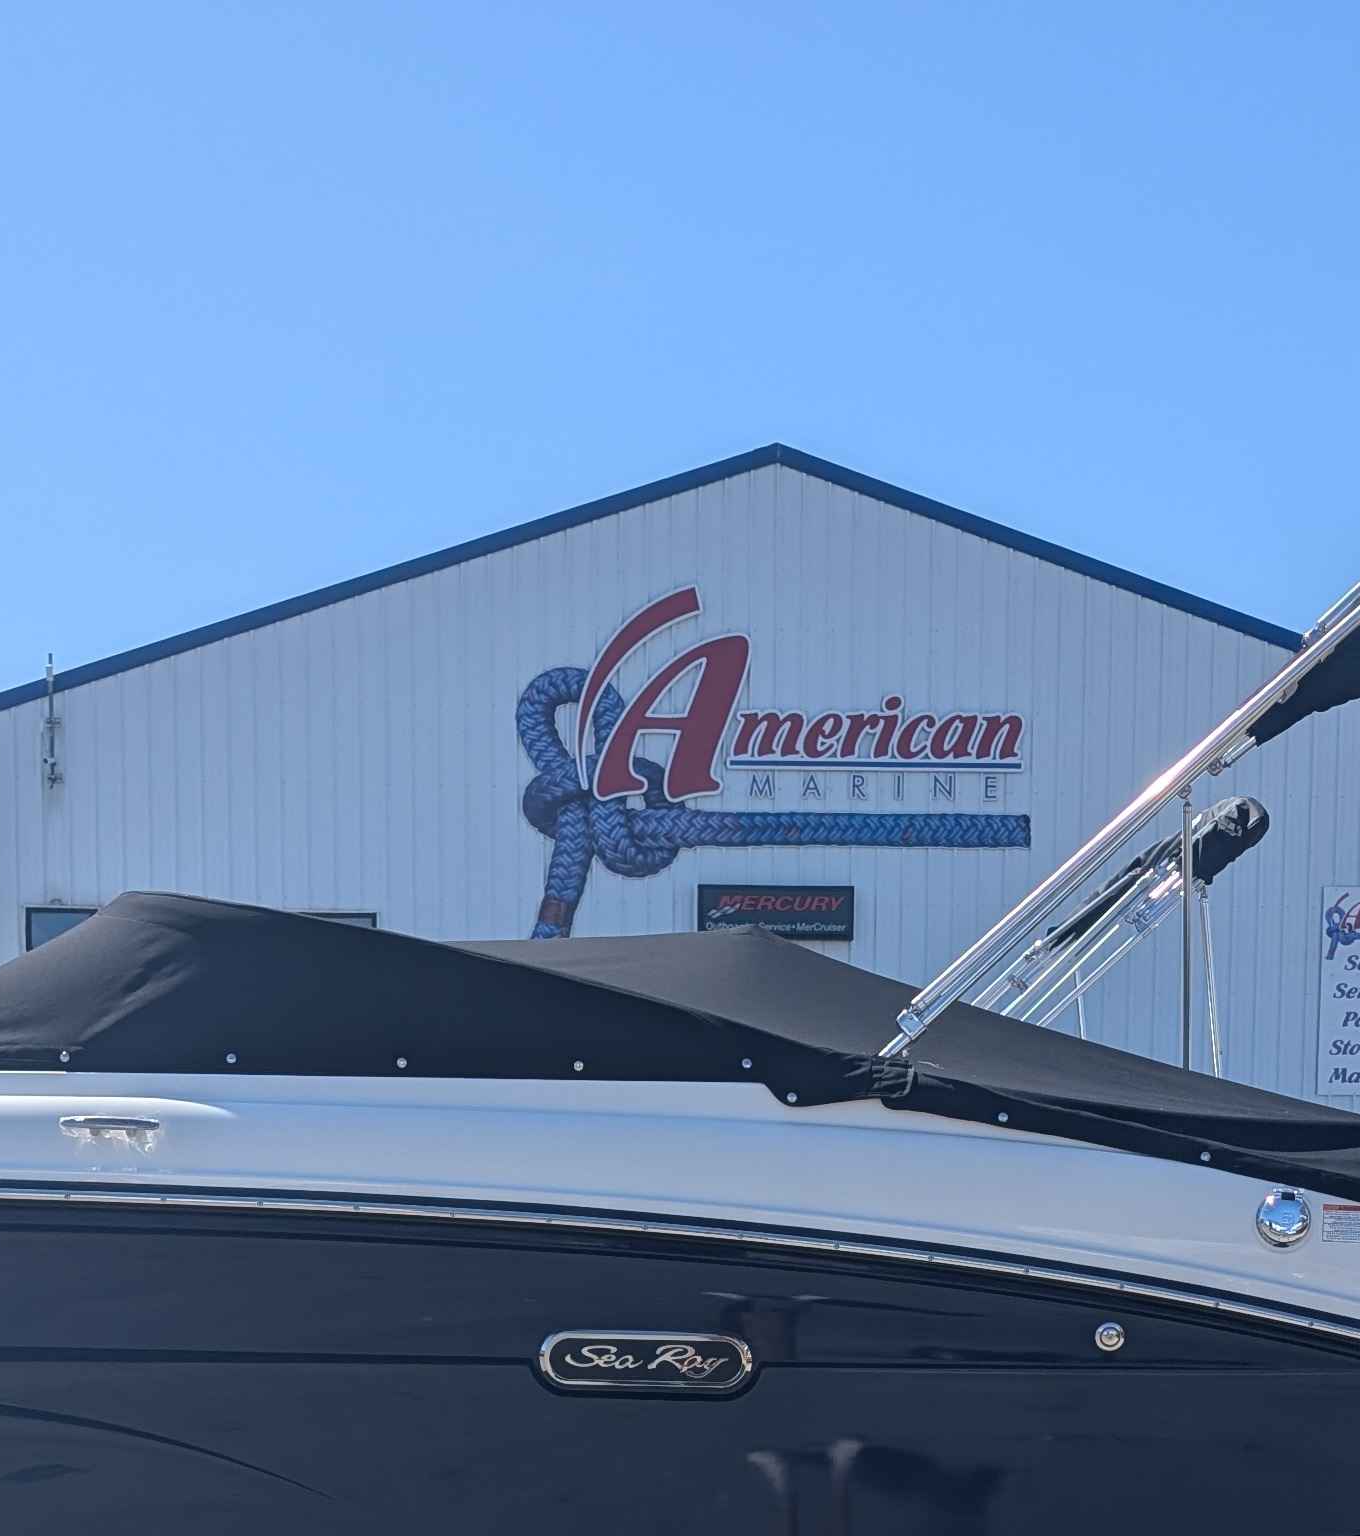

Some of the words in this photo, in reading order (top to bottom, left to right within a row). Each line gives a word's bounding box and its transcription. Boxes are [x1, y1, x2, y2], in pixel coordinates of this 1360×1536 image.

[595, 633, 1026, 801] American
[749, 773, 998, 800] MARINE
[719, 895, 846, 912] MERCURY
[564, 1345, 643, 1368] Sea
[647, 1344, 729, 1378] Ray
